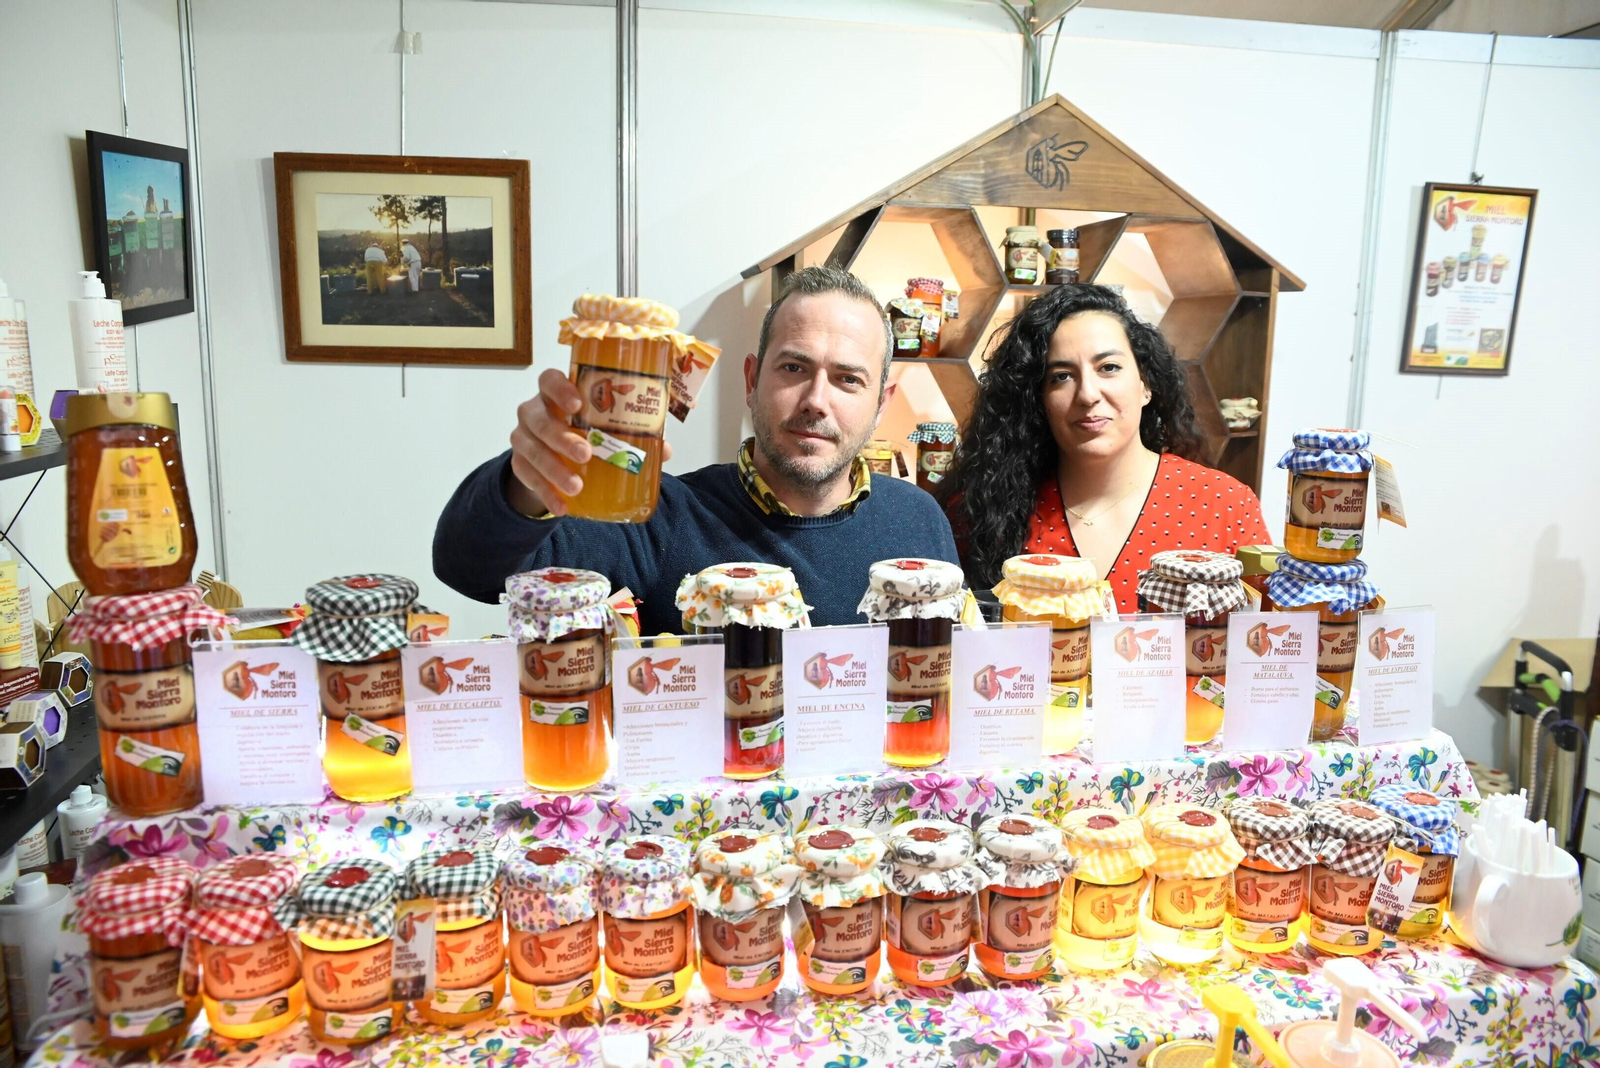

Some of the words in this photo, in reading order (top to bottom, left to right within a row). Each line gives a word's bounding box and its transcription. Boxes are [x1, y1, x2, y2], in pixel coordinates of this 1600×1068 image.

[1486, 205, 1506, 215] MIEL
[1466, 215, 1490, 223] SIERRA
[647, 387, 662, 397] Miel
[637, 394, 660, 407] Sierra
[625, 402, 659, 415] Montoro
[1352, 489, 1364, 498] Miel
[1344, 497, 1364, 506] Sierra
[1334, 504, 1362, 513] Montoro
[1158, 636, 1172, 644] Miel
[1288, 632, 1302, 640] Miel
[1403, 635, 1415, 643] Miel
[1071, 644, 1088, 654] Sierra
[1151, 645, 1171, 653] Sierra
[1282, 640, 1302, 648] Sierra
[577, 645, 594, 657] Miel
[1274, 648, 1301, 656] Montoro
[1392, 650, 1415, 659] Montoro
[568, 656, 594, 668] Sierra
[1144, 653, 1171, 661] Montoro
[473, 665, 490, 674] Miel
[558, 664, 595, 677] Montoro
[680, 665, 696, 674] Miel
[852, 661, 867, 670] Miel
[279, 671, 296, 680] Miel
[381, 669, 400, 680] Miel
[466, 675, 491, 683] Sierra
[672, 675, 696, 683] Sierra
[844, 670, 866, 679] Sierra
[1020, 674, 1034, 683] Miel
[158, 677, 180, 688] Miel
[271, 680, 296, 689] Sierra
[371, 680, 400, 690] Sierra
[836, 679, 866, 688] Montoro
[1013, 682, 1034, 691] Sierra
[457, 684, 491, 692] Montoro
[663, 684, 696, 693] Montoro
[147, 688, 180, 700] Sierra
[262, 690, 297, 699] Montoro
[361, 688, 400, 700] Montoro
[1004, 691, 1034, 700] Montoro
[136, 697, 181, 710] Montoro
[623, 705, 643, 713] MIEL
[658, 702, 700, 711] CANTUESO
[1289, 877, 1302, 889] Miel
[1379, 883, 1394, 893] MIEL
[1280, 887, 1301, 898] Sierra
[1376, 890, 1400, 902] SIERRA
[1270, 896, 1300, 906] Montoro
[1374, 896, 1405, 911] MONTORO
[856, 909, 873, 923] Miel
[654, 926, 674, 938] Miel
[847, 921, 873, 933] Sierra
[836, 929, 873, 942] Montoro
[568, 936, 592, 952] Sierra
[645, 937, 674, 948] Sierra
[634, 945, 674, 957] Montoro
